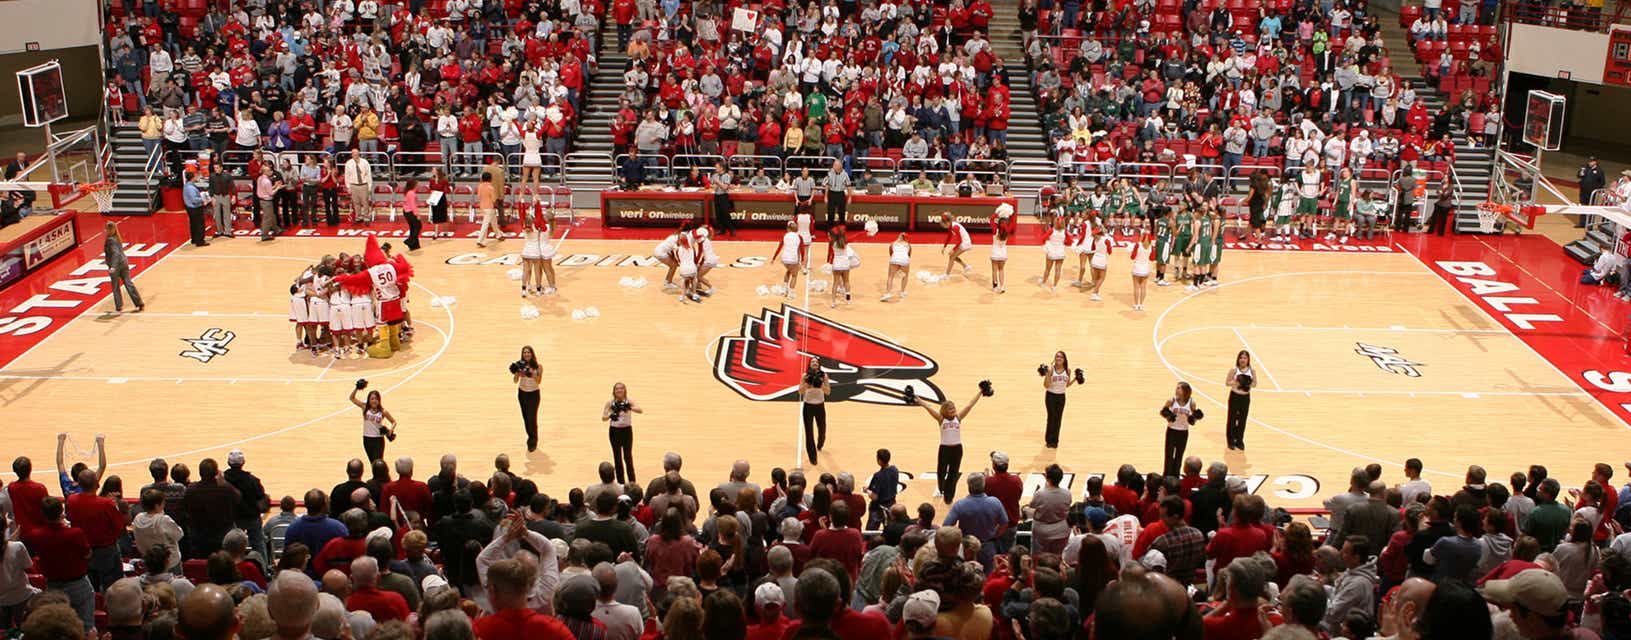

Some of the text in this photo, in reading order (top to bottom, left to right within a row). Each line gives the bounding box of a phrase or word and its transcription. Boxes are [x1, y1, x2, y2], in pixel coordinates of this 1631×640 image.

[1312, 243, 1393, 251] Arena
[444, 252, 768, 268] CADINS
[377, 271, 394, 286] 50
[1435, 260, 1565, 330] BALL
